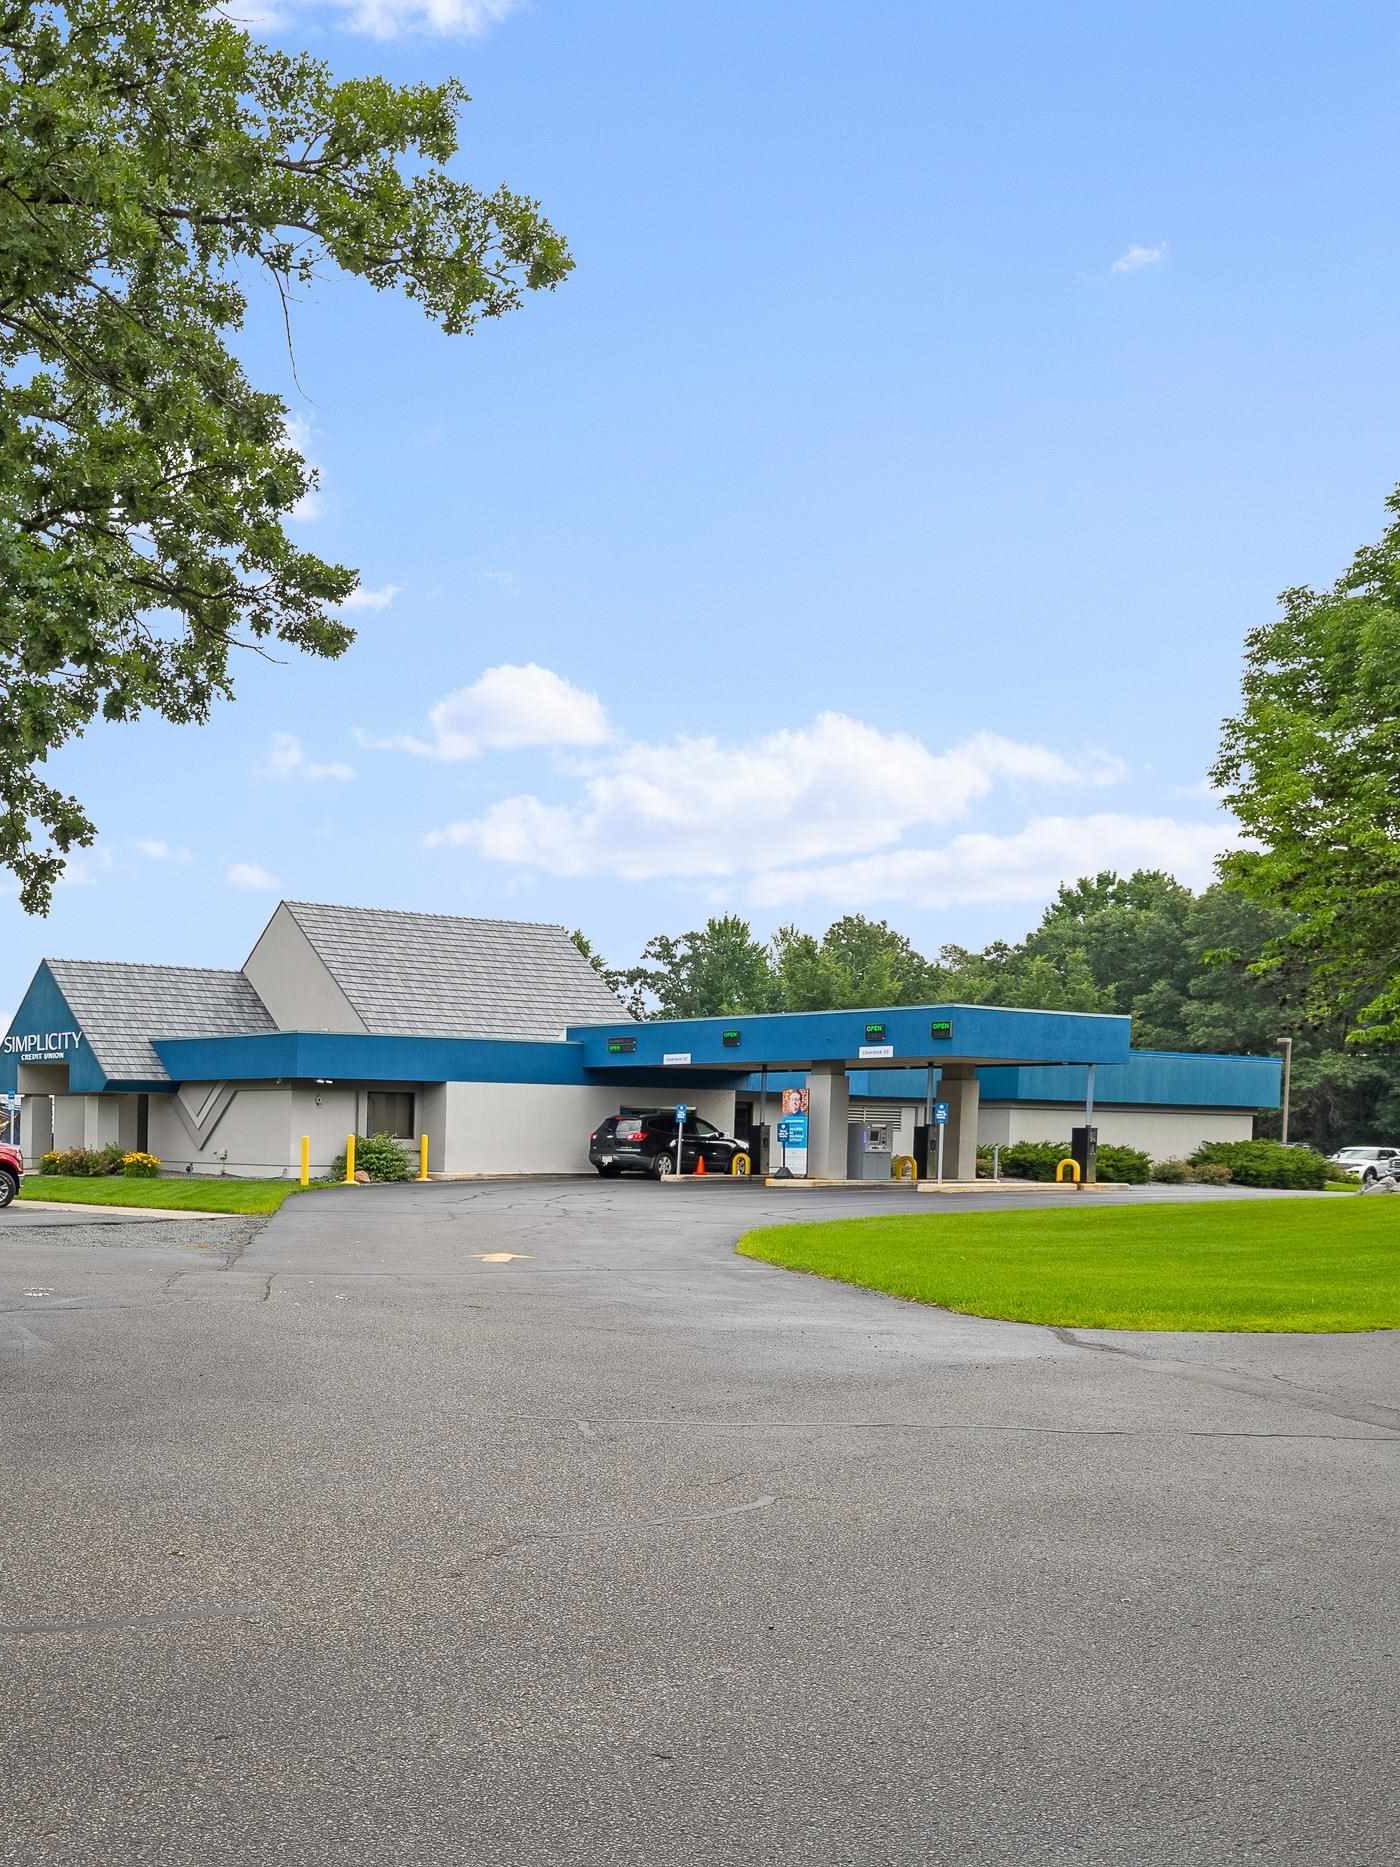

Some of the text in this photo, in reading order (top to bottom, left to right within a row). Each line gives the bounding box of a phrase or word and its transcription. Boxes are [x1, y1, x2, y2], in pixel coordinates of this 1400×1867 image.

[4, 1032, 82, 1053] SIMPLICITY
[21, 1052, 65, 1061] CREDIT UNION
